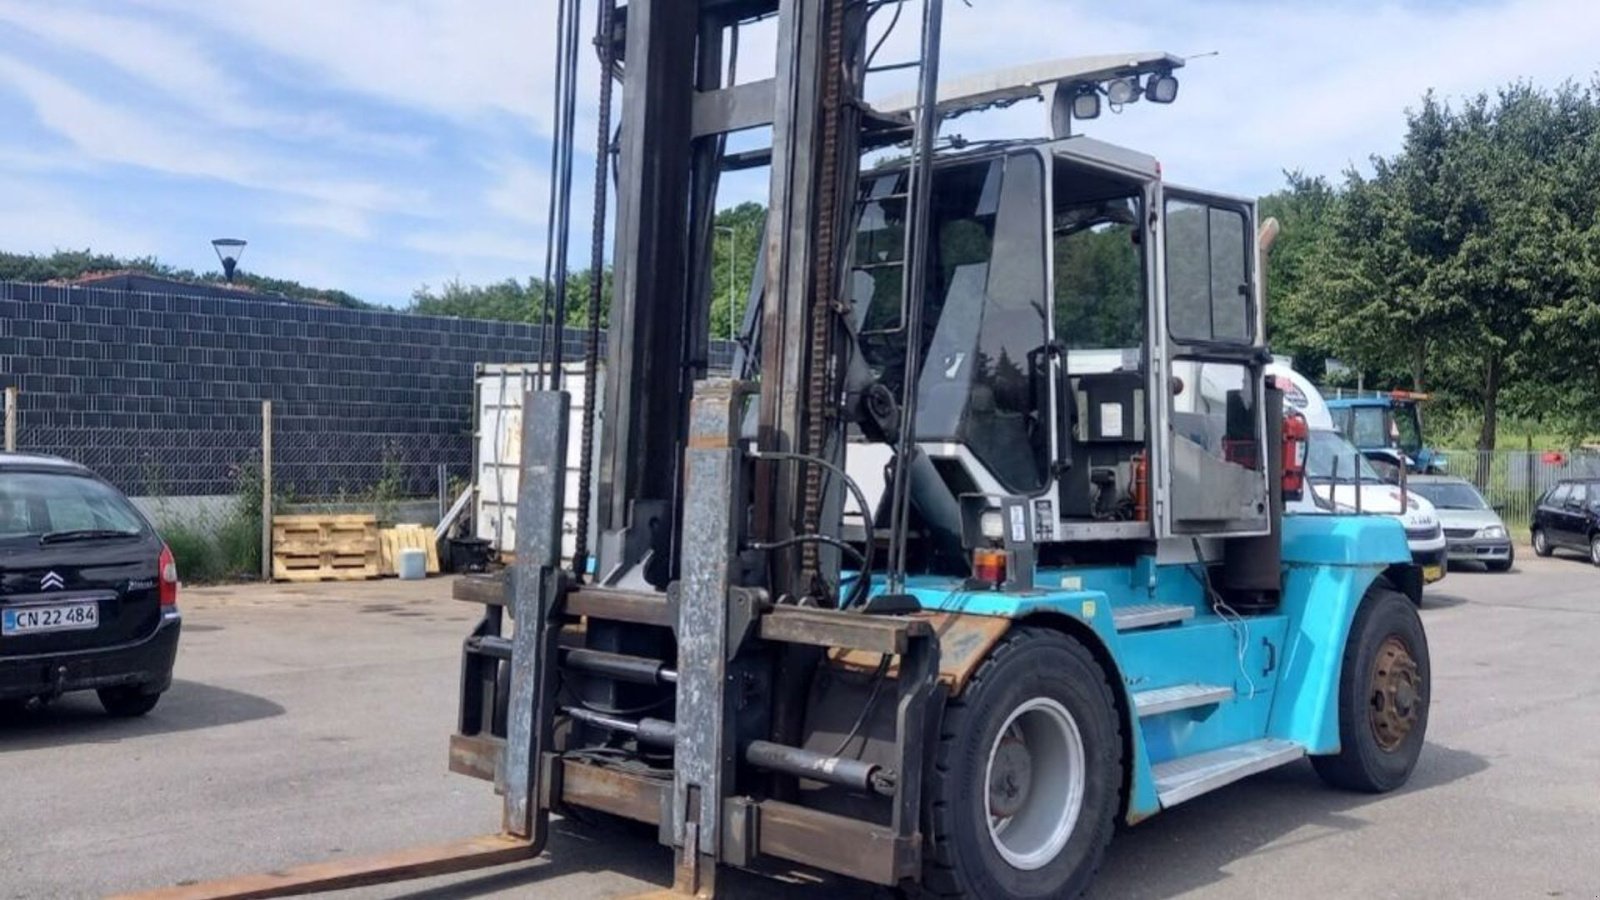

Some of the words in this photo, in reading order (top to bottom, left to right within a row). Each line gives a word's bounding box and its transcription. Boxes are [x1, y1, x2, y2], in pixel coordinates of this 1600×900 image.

[16, 611, 38, 627] CN
[42, 610, 62, 625] 22
[65, 607, 94, 623] 484
